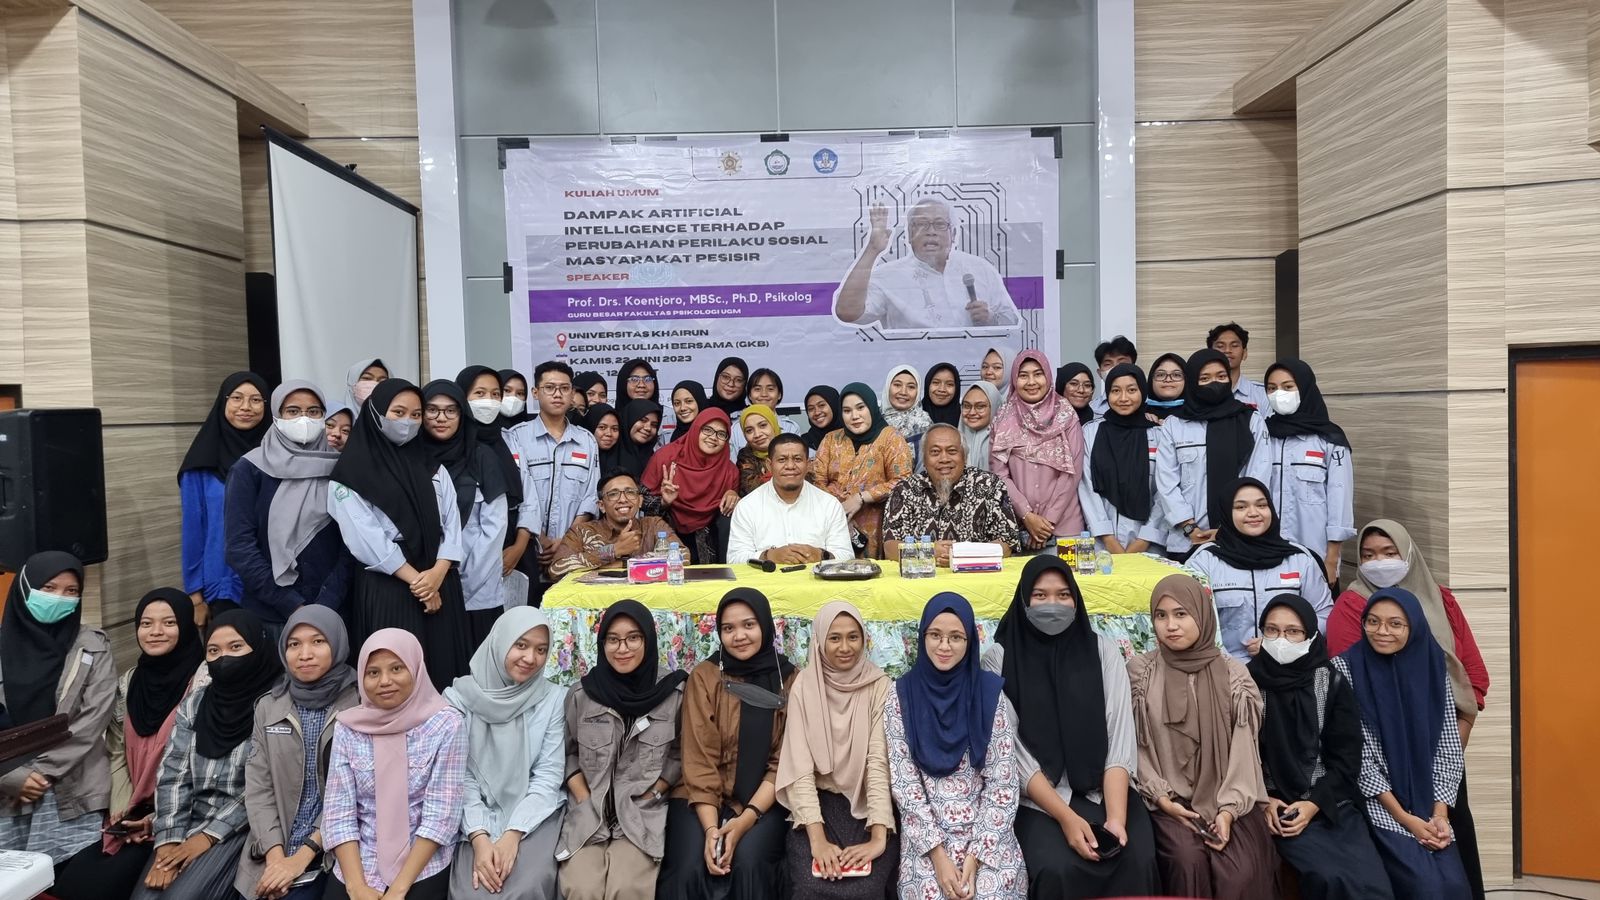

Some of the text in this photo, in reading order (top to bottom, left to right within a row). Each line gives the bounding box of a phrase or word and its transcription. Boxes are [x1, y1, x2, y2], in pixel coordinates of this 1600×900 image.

[564, 188, 660, 198] KULIAH UMUM
[563, 208, 743, 220] DAMPAK ARTIFICIAL
[564, 222, 785, 235] INTELLIGENCE TERHADAP
[565, 236, 829, 250] PERUBAHAN PERILAKU SOSIAL
[566, 253, 760, 266] MASYARAKAT PESISIR
[566, 273, 630, 281] SPEAKER
[567, 292, 812, 307] Prof. Drs. Koentjoro, MBSc., Ph.D, Psikolog
[568, 329, 709, 339] UNIVERSITAS KHAIRUN
[569, 340, 769, 352] GEDUNG KULIAH BERSAMA (GKB)
[662, 355, 692, 363] 2023
